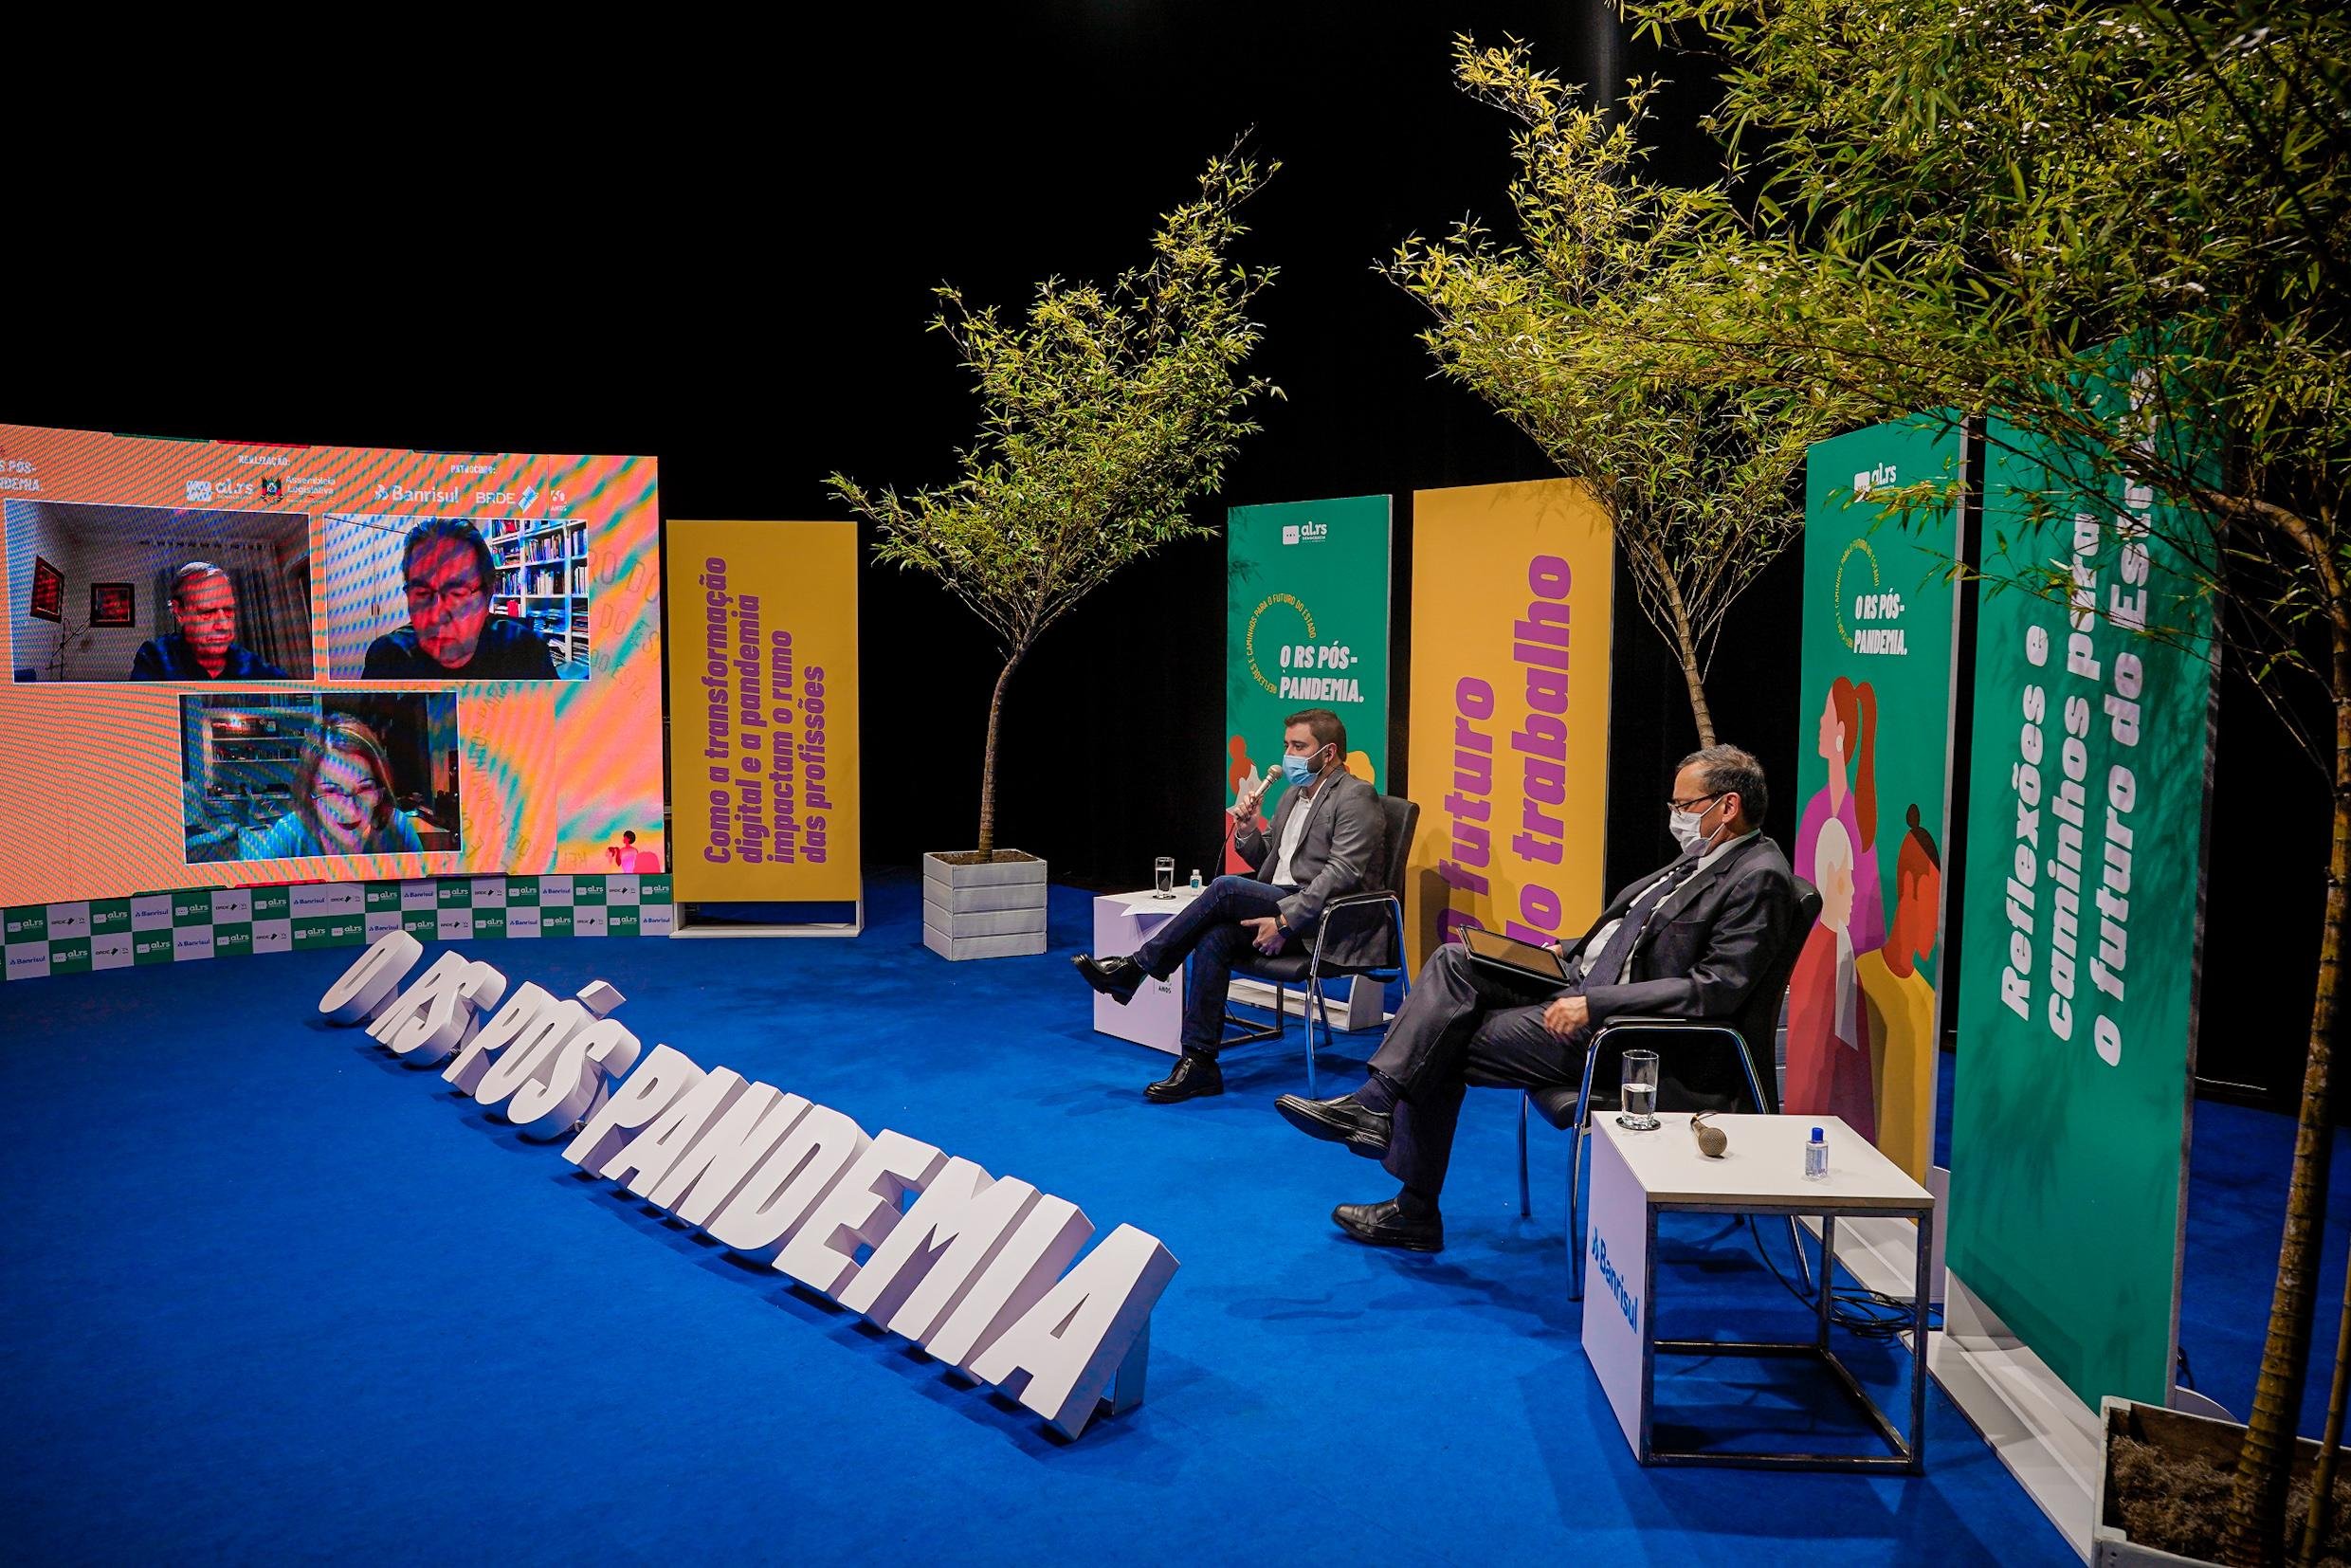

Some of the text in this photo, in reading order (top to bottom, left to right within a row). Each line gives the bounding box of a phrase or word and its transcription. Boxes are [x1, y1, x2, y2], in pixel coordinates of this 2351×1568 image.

[392, 485, 459, 503] Banrisul
[476, 491, 516, 504] BRDE
[1301, 520, 1328, 536] al.rs
[1247, 616, 1257, 656] CAMINHOS
[1254, 600, 1268, 617] PARA
[1273, 593, 1296, 606] FUTURO
[1295, 600, 1303, 612] DO
[1302, 609, 1317, 639] ESTADO
[1853, 629, 1908, 655] PANDEMIA.
[1854, 587, 1905, 620] O RS PÓS-
[1279, 640, 1358, 669] O RS PÓS-
[1279, 676, 1364, 702] PANDEMIA.
[2104, 651, 2143, 747] do
[699, 556, 734, 864] Como a transformação
[732, 594, 770, 864] digital e a pandemia
[767, 629, 801, 864] impactam o rumo
[1511, 554, 1572, 866] trabalho
[797, 665, 832, 864] das profissões
[1438, 676, 1495, 896] futuro
[2000, 625, 2049, 1022] Reflexões e
[2048, 695, 2090, 1041] caminhos
[2089, 764, 2137, 1002] futuro
[2093, 1014, 2122, 1067] o
[319, 929, 1176, 1438] O RS PÓS PANDEMIA
[1598, 1238, 1638, 1335] Banrisul
